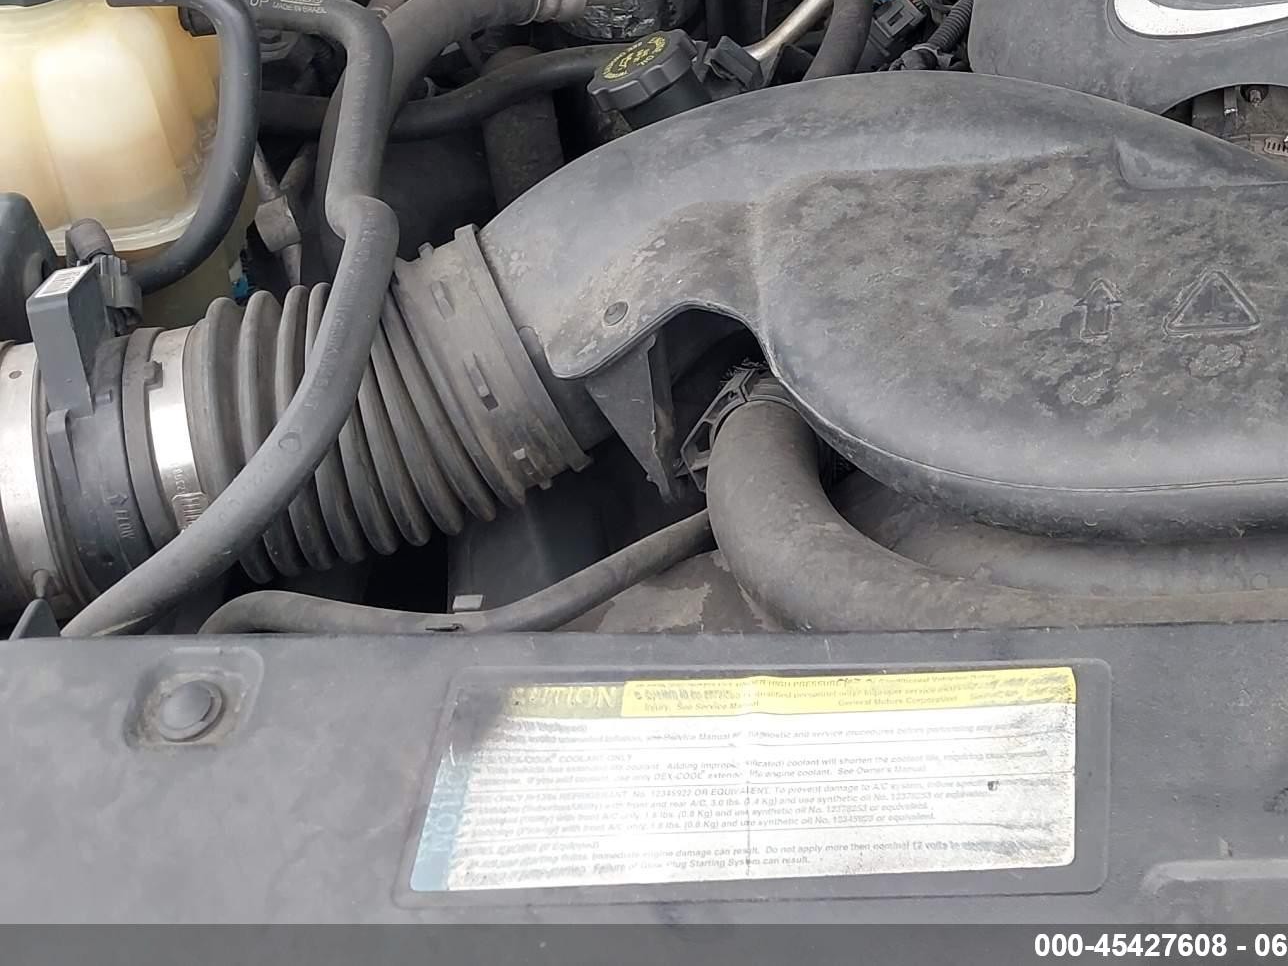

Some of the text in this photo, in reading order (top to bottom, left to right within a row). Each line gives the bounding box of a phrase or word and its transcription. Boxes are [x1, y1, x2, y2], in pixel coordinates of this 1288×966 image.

[787, 758, 819, 767] coolant
[822, 757, 836, 766] will
[839, 755, 872, 764] shorten
[694, 788, 708, 797] OR
[779, 795, 796, 805] and
[798, 796, 814, 804] use
[816, 793, 858, 805] synthetic
[698, 808, 713, 820] Kg)
[716, 808, 732, 818] and
[752, 806, 793, 818] synthetic
[703, 819, 719, 830] Kg)
[721, 819, 738, 828] and
[758, 817, 799, 829] synthetic
[675, 848, 712, 859] damage
[714, 848, 730, 856] can
[765, 845, 778, 854] Do
[780, 845, 796, 854] not
[797, 843, 823, 855] apply
[825, 844, 849, 853] more
[689, 857, 725, 869] Starting
[762, 856, 779, 866] can
